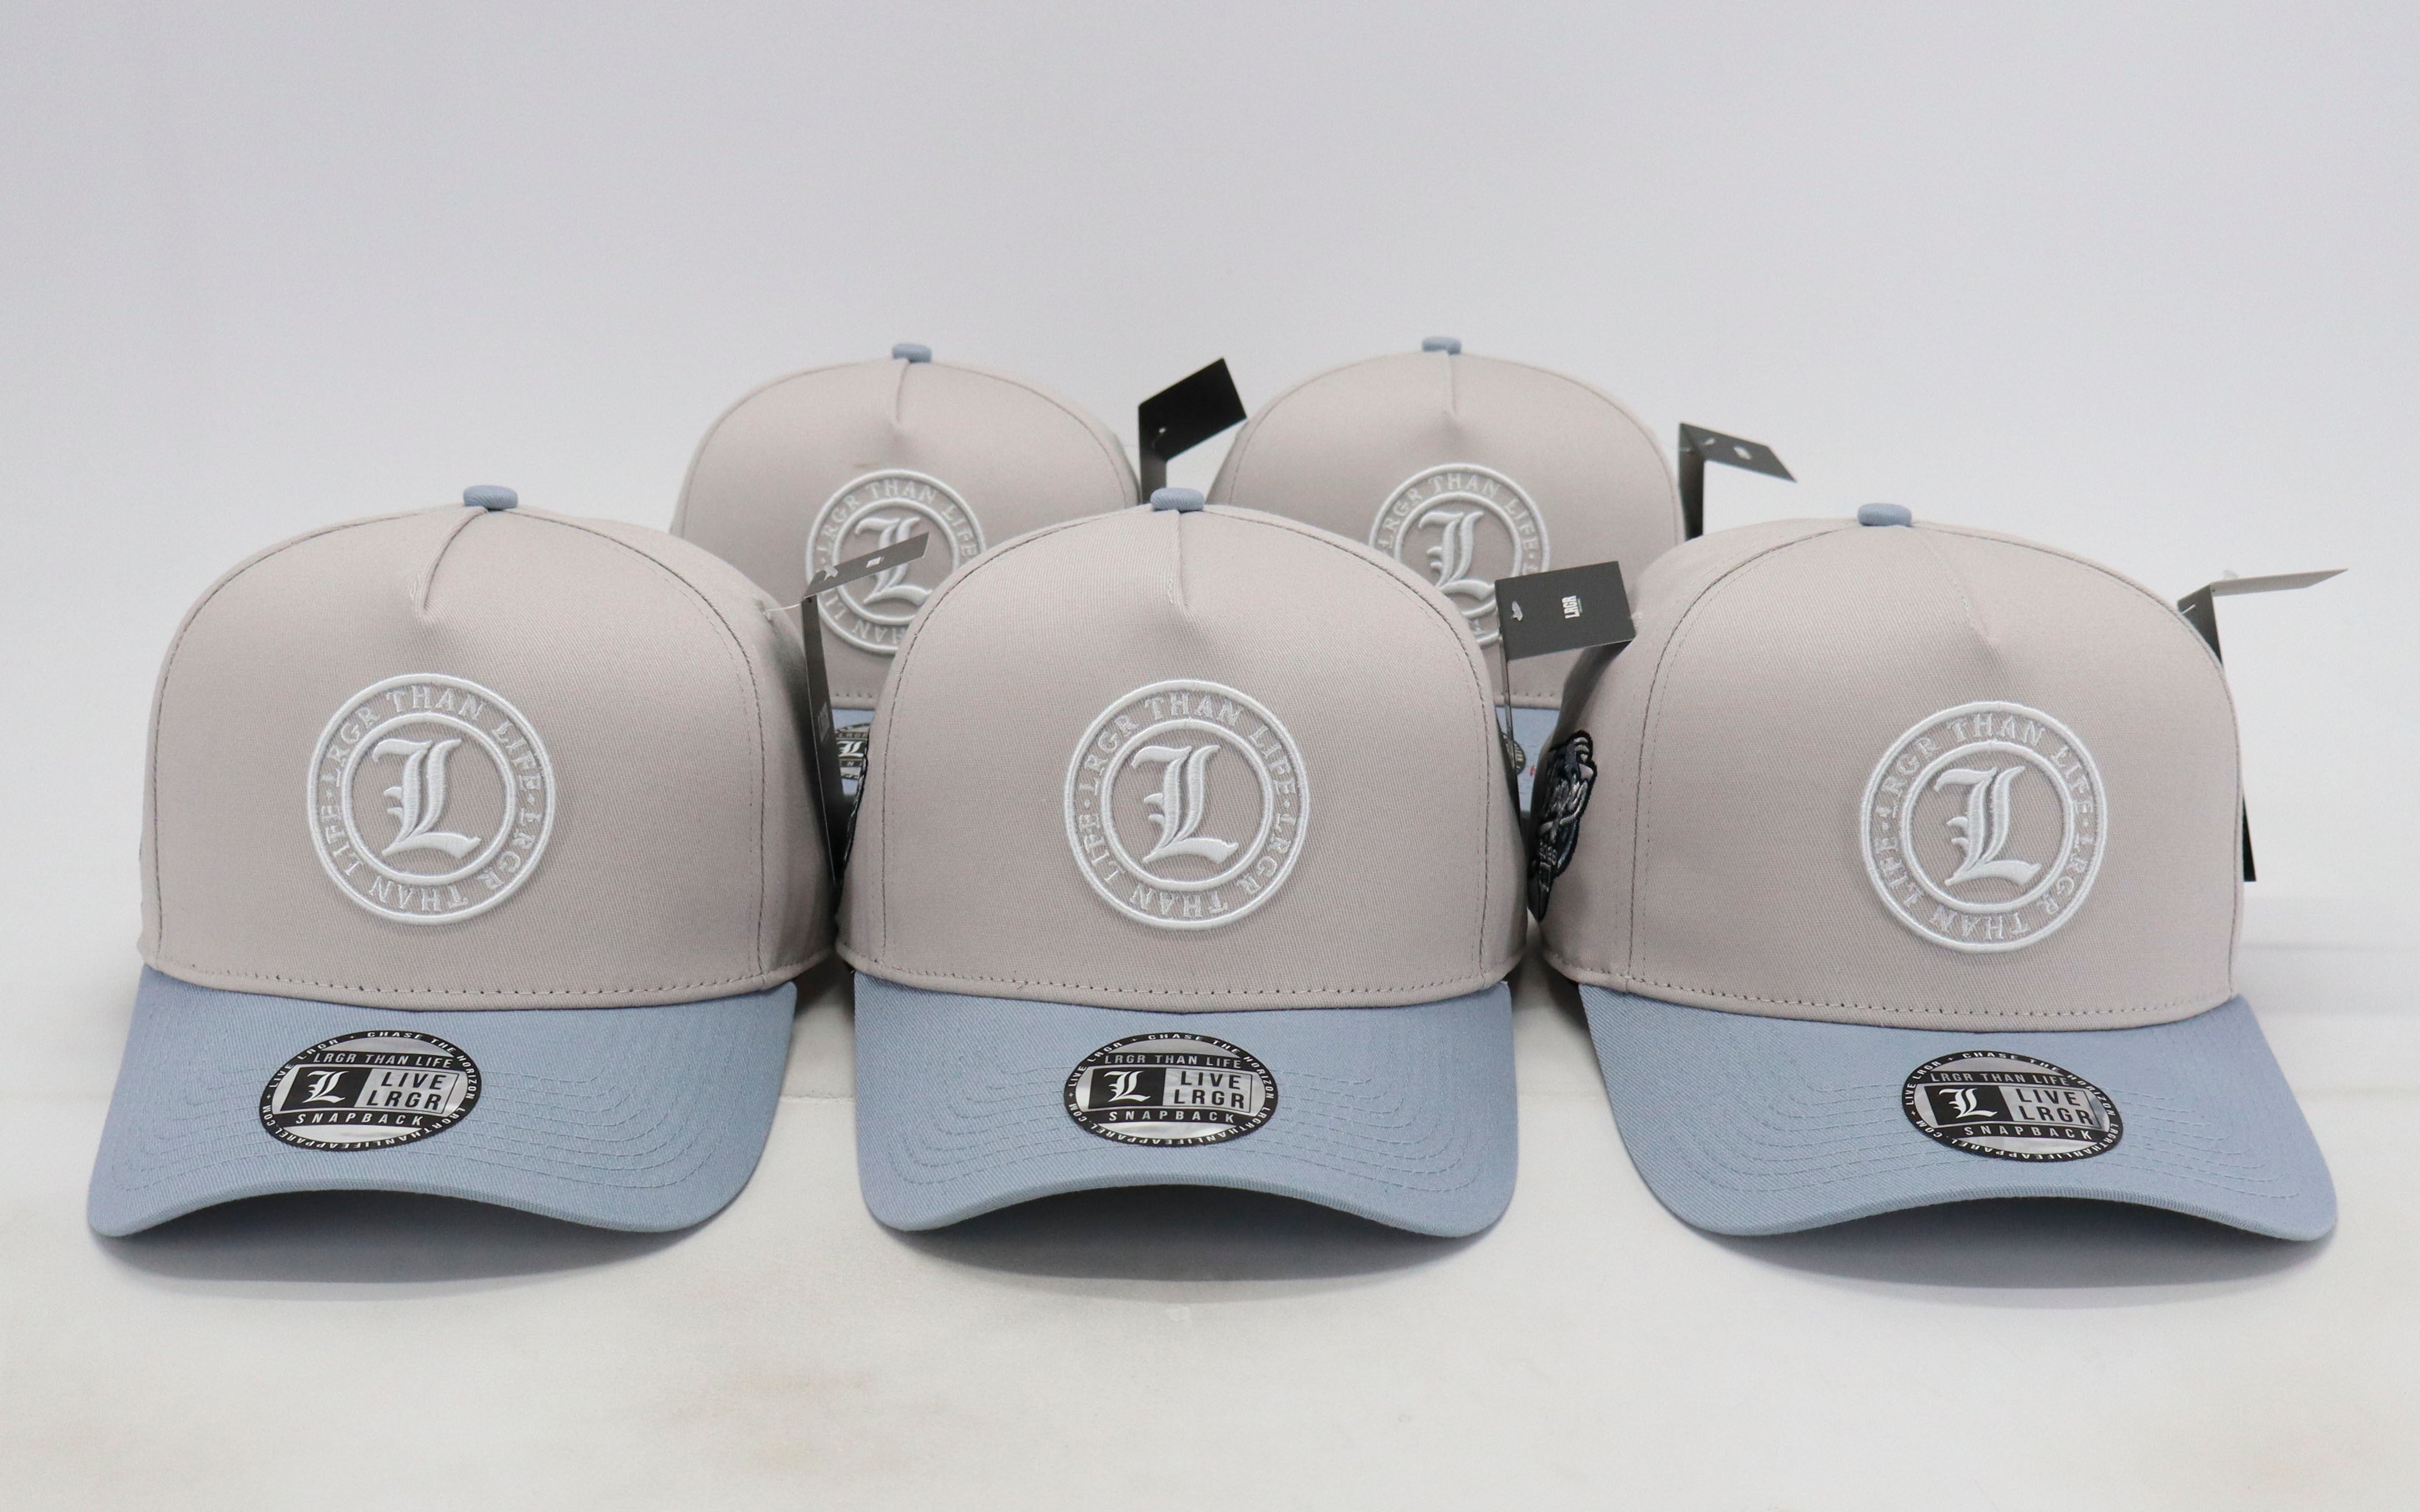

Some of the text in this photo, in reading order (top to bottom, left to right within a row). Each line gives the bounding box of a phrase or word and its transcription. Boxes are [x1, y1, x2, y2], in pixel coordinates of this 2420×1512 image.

[866, 478, 936, 503] THAN
[942, 506, 978, 557] LIFE
[1429, 473, 1500, 498] THAN
[1505, 499, 1538, 551] LIFE
[1561, 595, 1580, 619] LRGR
[322, 685, 542, 791] LRGR THAN LIFE
[1079, 694, 1296, 795] LRGR THAN LIFE
[1876, 713, 2094, 819] LRGR THAN LIFE
[372, 738, 482, 859] L
[1131, 745, 1239, 864] L
[1933, 766, 2042, 887] L
[321, 805, 540, 912] LRGR THAN LIFE
[1079, 813, 1296, 918] LRGR THAN LIFE
[1874, 833, 2094, 941] LRGR THAN LIFE
[269, 1039, 339, 1088] LIVE LRGR
[313, 1053, 454, 1068] LRGR THAN LIFE
[367, 1031, 478, 1100] CHASE THE HORIZON
[381, 1071, 446, 1090] LIVE
[1068, 1042, 1123, 1087] LIVE LRGR
[1104, 1055, 1242, 1068] LRGR THAN LIFE
[1181, 1071, 1241, 1090] LIVE
[1212, 1040, 1241, 1055] THE
[1243, 1056, 1275, 1100] HORIZON
[1905, 1060, 1942, 1106] LIVE LRGR
[1930, 1073, 2070, 1086] LRGR THAN LIFE
[302, 1071, 350, 1103] L
[366, 1090, 442, 1111] LRGR
[1103, 1071, 1152, 1103] L
[1174, 1089, 1244, 1110] LRGR
[1938, 1088, 1998, 1119] L
[2015, 1088, 2081, 1107] LIVE
[2030, 1059, 2060, 1072] THE
[2067, 1074, 2116, 1117] HORIZON
[295, 1113, 423, 1126] SNAPBACK
[1109, 1110, 1234, 1123] SNAPBACK
[1964, 1125, 2092, 1140] SNAPBACK
[2019, 1105, 2095, 1126] LRGR
